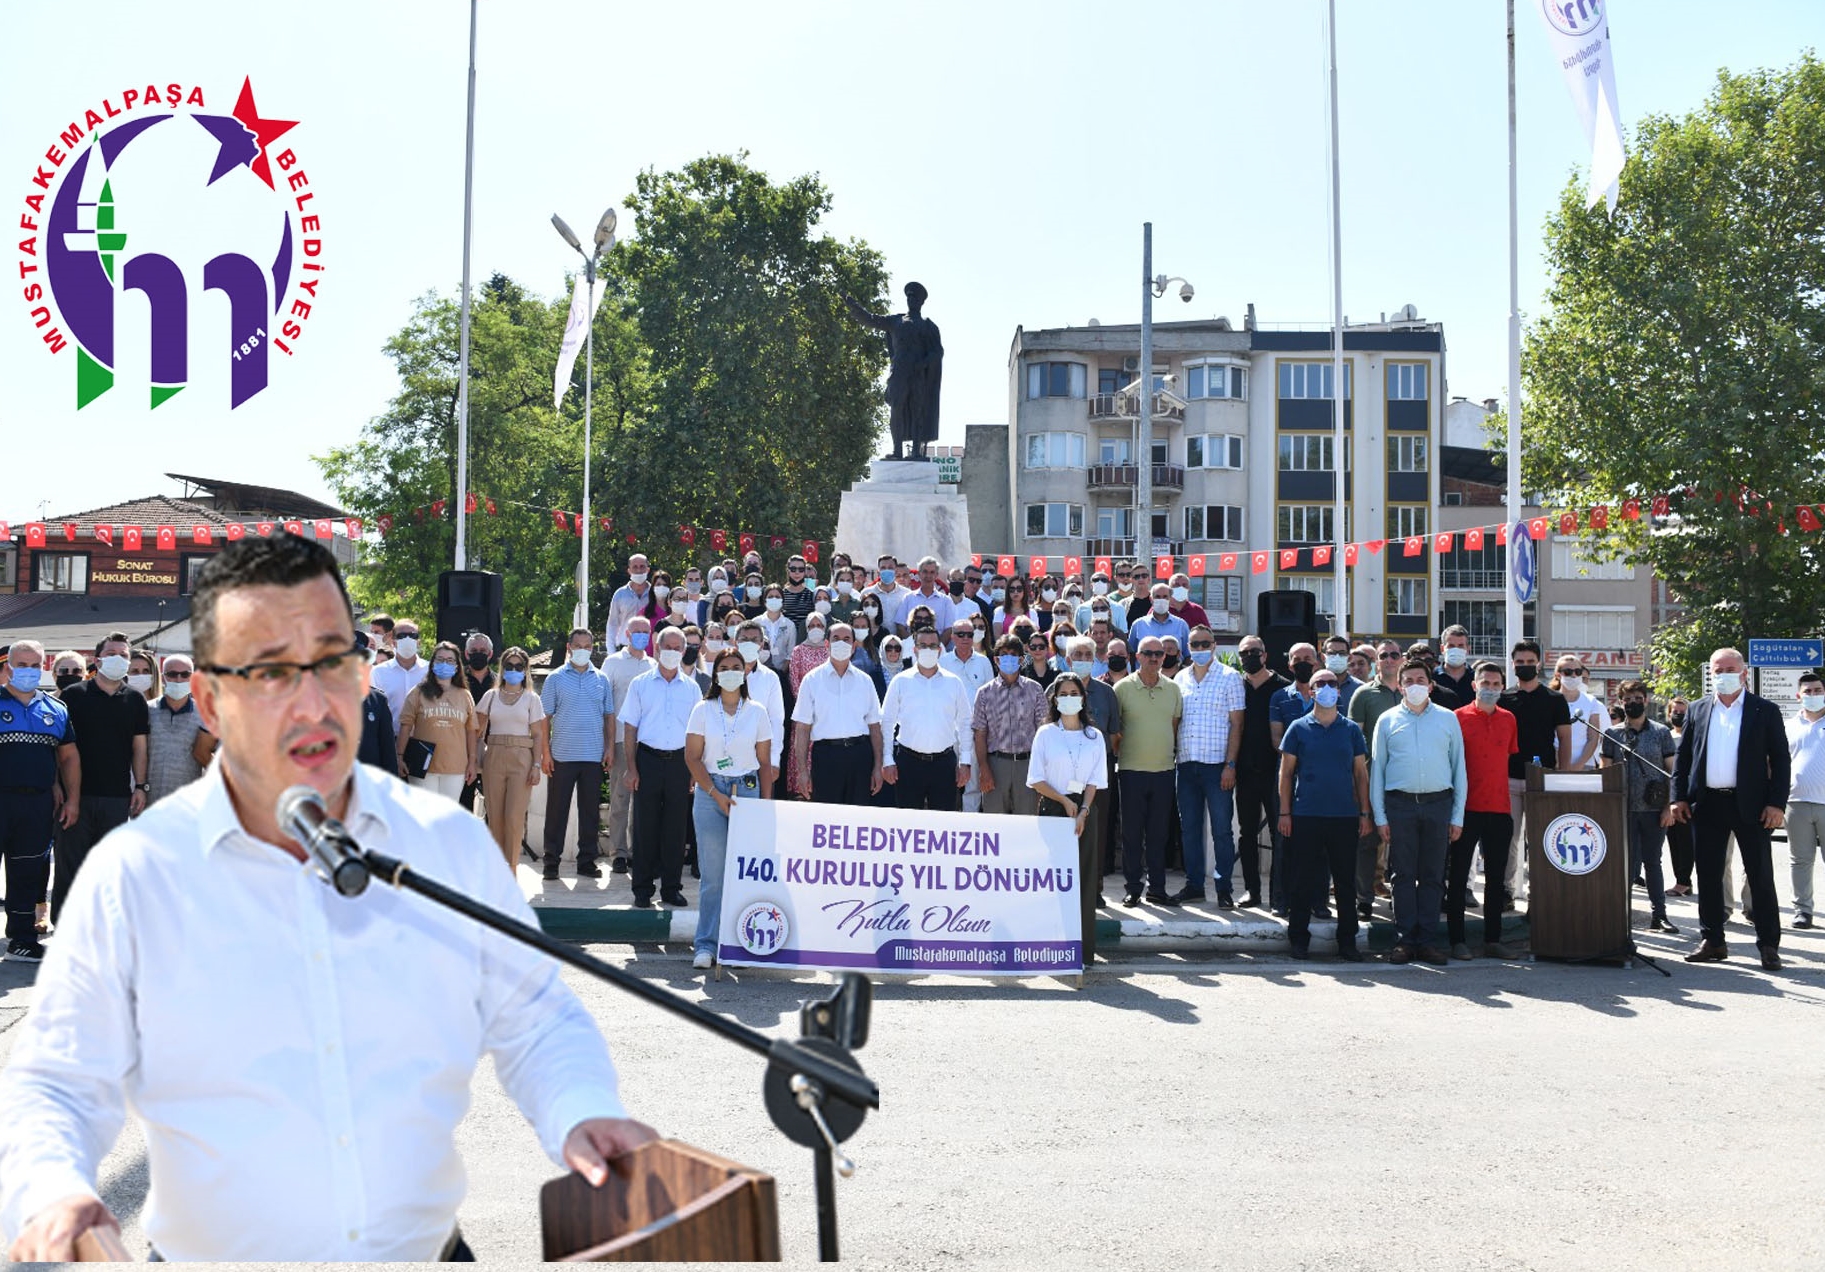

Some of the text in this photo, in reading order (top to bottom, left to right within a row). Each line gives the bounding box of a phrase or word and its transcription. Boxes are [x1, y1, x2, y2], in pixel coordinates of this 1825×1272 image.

[116, 559, 154, 570] SONAT
[92, 572, 177, 584] HUKUK BÜROSU
[1544, 651, 1644, 666] EZANE
[737, 856, 1074, 895] 140. KURULUŞ YIL DÖNÜMÜ
[821, 899, 911, 938] Kutlu
[921, 905, 992, 933] Olsun
[895, 945, 1075, 964] Mustafakemalpaşa Belediyesi
